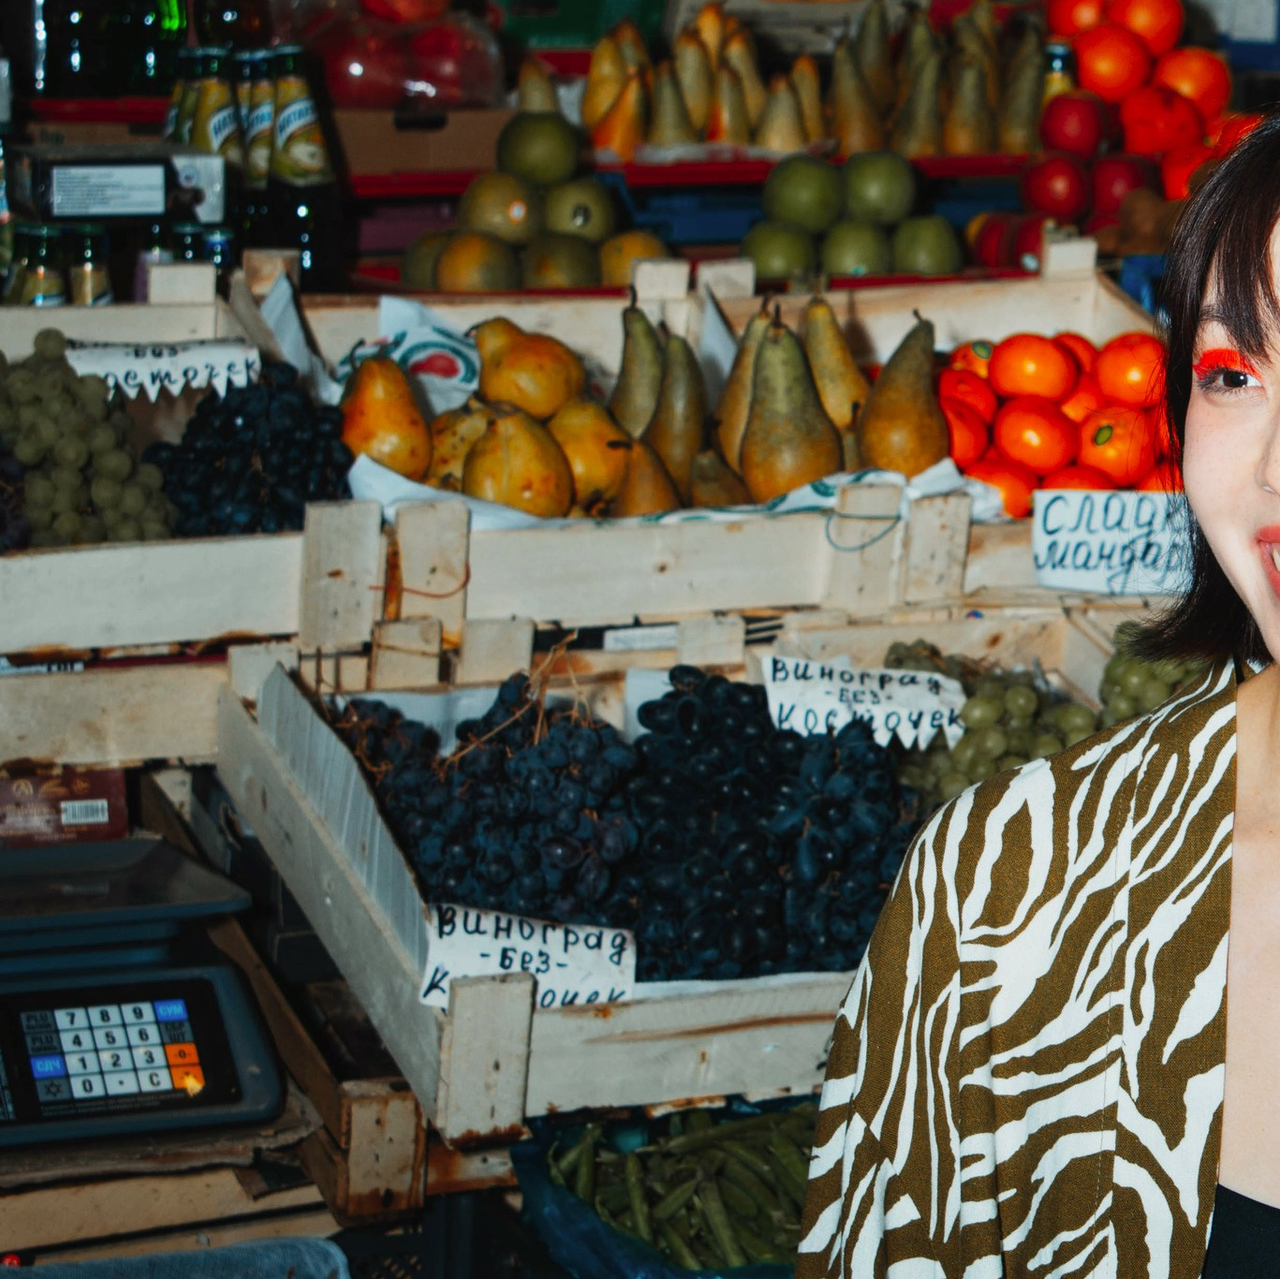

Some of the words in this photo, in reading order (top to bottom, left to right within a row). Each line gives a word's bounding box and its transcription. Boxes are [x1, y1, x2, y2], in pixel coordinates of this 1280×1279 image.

[772, 656, 942, 695] Виноград
[437, 905, 627, 965] Виноград
[67, 1012, 77, 1025] 7
[100, 1009, 110, 1022] 8
[133, 1006, 144, 1019] 9
[72, 1034, 83, 1047] 4
[105, 1031, 116, 1044] 5
[139, 1028, 149, 1041] 6
[78, 1056, 88, 1069] 1
[111, 1053, 121, 1067] 2
[144, 1050, 155, 1064] 3
[82, 1079, 93, 1093] 0
